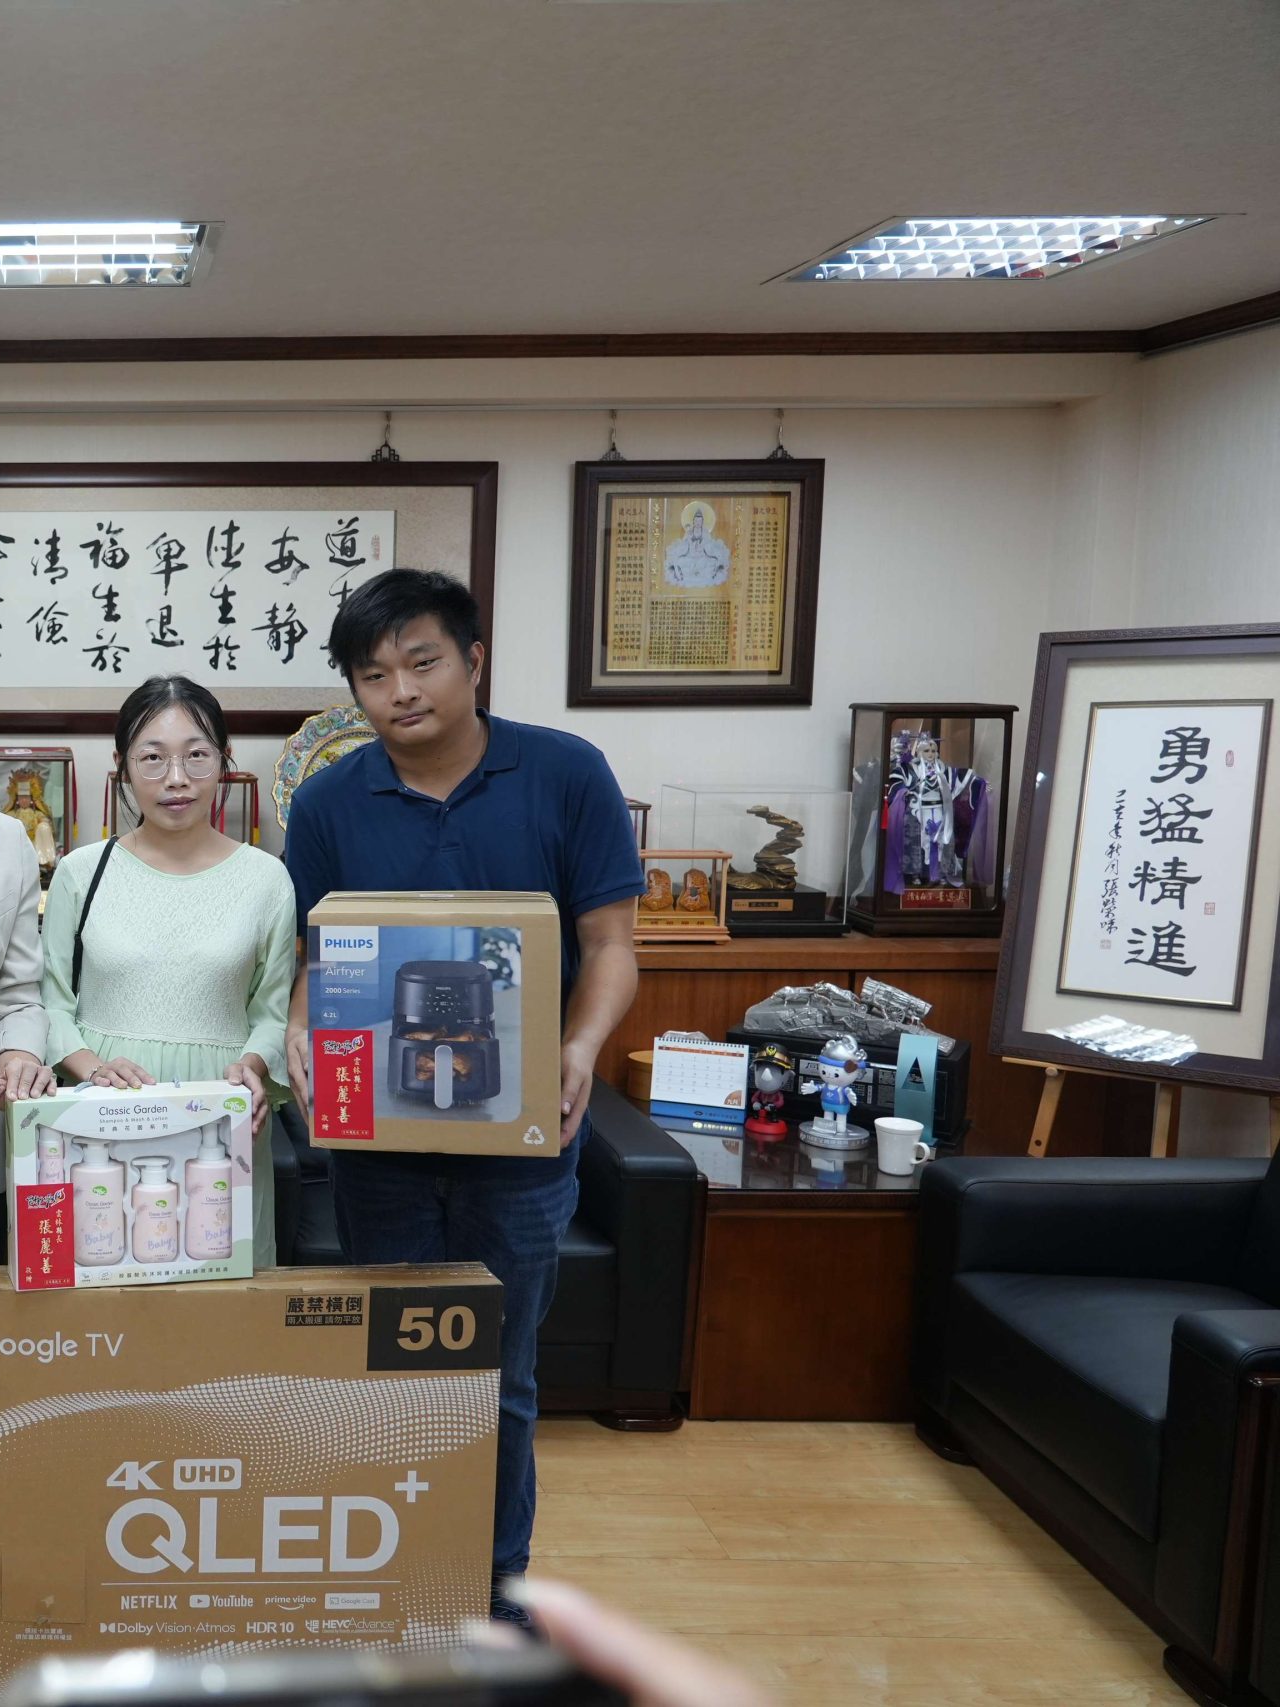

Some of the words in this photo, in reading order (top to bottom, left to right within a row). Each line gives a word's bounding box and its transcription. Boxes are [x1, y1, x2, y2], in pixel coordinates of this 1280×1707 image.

[1124, 726, 1214, 977] 勇猛精進
[324, 938, 374, 949] PHILIPS
[325, 965, 366, 979] Airfryer
[336, 1066, 351, 1124] 張麗善
[98, 1107, 131, 1116] Classic
[133, 1105, 168, 1114] Garden
[39, 1219, 53, 1274] 張麗善
[287, 1296, 363, 1313] 嚴禁橫倒
[396, 1305, 477, 1351] 50
[85, 1333, 124, 1358] TV
[106, 1460, 165, 1490] 4K
[179, 1465, 236, 1484] UHD
[120, 1594, 178, 1611] NETFLIX
[212, 1594, 254, 1609] YouTube
[265, 1595, 290, 1605] prime
[292, 1595, 317, 1604] video
[118, 1621, 154, 1634] Dolby
[246, 1621, 277, 1634] HDR
[280, 1621, 295, 1633] 10
